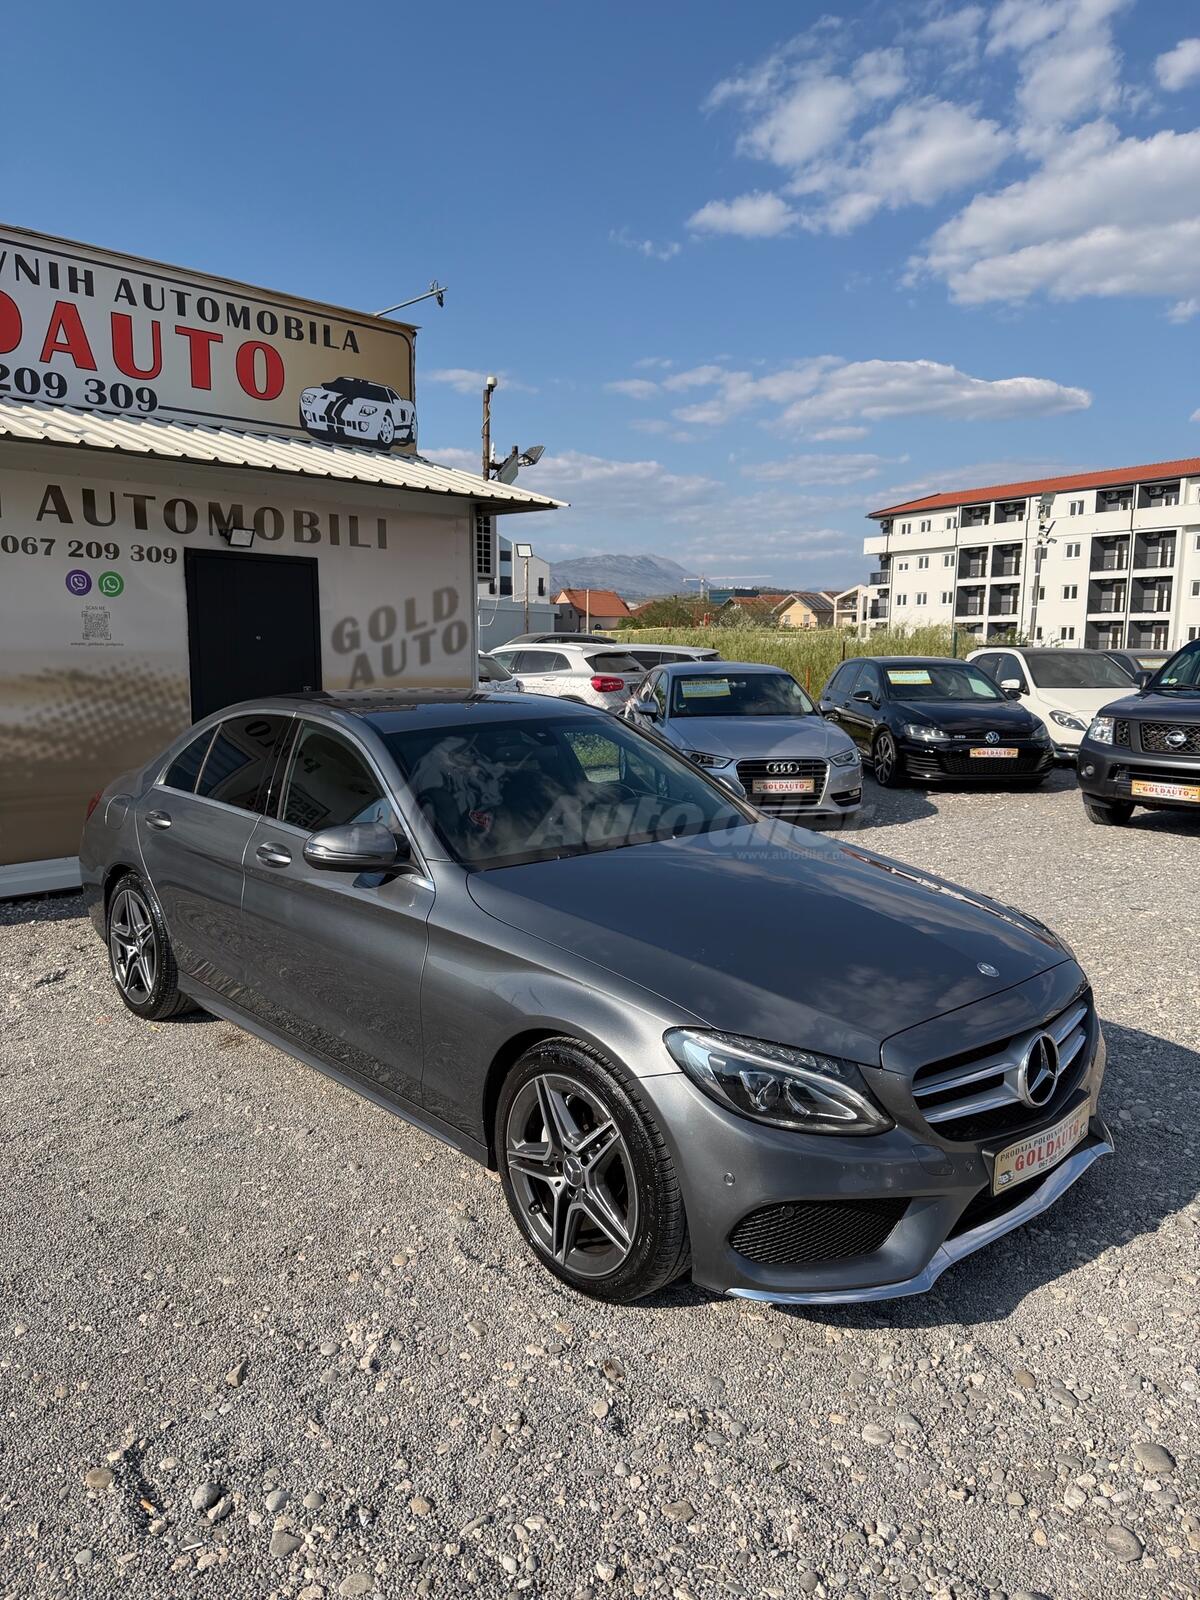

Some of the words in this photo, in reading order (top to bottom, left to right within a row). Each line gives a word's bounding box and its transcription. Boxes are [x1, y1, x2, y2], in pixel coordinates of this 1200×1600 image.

[114, 277, 360, 354] AUTOMOBILA
[84, 378, 159, 413] 309
[36, 484, 388, 550] AUTOMOBILI
[1, 535, 56, 556] 067
[68, 540, 120, 560] 209
[130, 544, 178, 564] 309
[331, 586, 459, 655] GOLD
[347, 619, 468, 689] AUTO
[1143, 786, 1189, 797] GOLDAUTO
[1000, 1141, 1032, 1162] PRODAJA
[1014, 1119, 1080, 1171] GOLDAUTO
